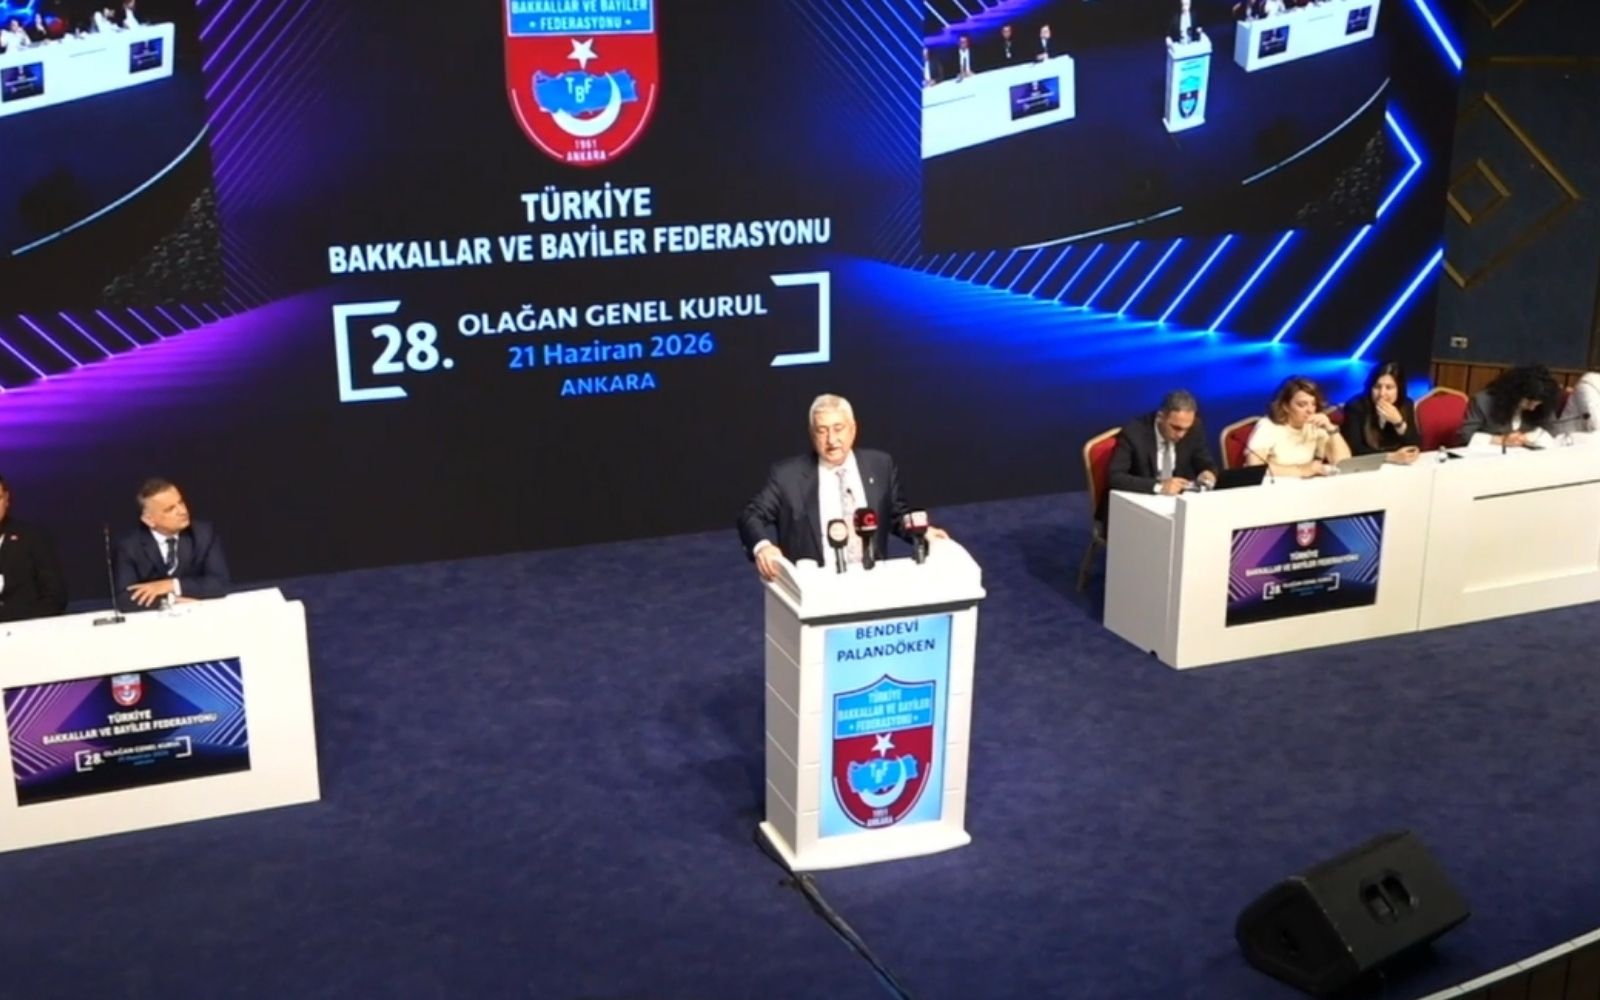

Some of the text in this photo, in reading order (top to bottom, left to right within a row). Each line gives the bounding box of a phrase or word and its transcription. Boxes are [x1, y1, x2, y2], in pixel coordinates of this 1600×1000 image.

[582, 0, 598, 13] VE
[540, 16, 622, 31] FEDERASYONU
[567, 150, 606, 161] ANKARA
[521, 182, 652, 223] TÜRKİYE
[328, 217, 832, 274] BAKKALLAR VE BAYİLER FEDERASYONU
[371, 294, 768, 375] 28. OLAĞAN GENEL KURUL
[508, 332, 714, 369] 21 Haziran 2026
[561, 373, 656, 397] ANKARA
[855, 620, 919, 640] BENDEVİ
[836, 639, 936, 662] PALANDÖKEN
[107, 709, 152, 724] TÜRKİYE
[42, 713, 218, 745] BAKKALLAR VE BAYİLER FEDERASYONU
